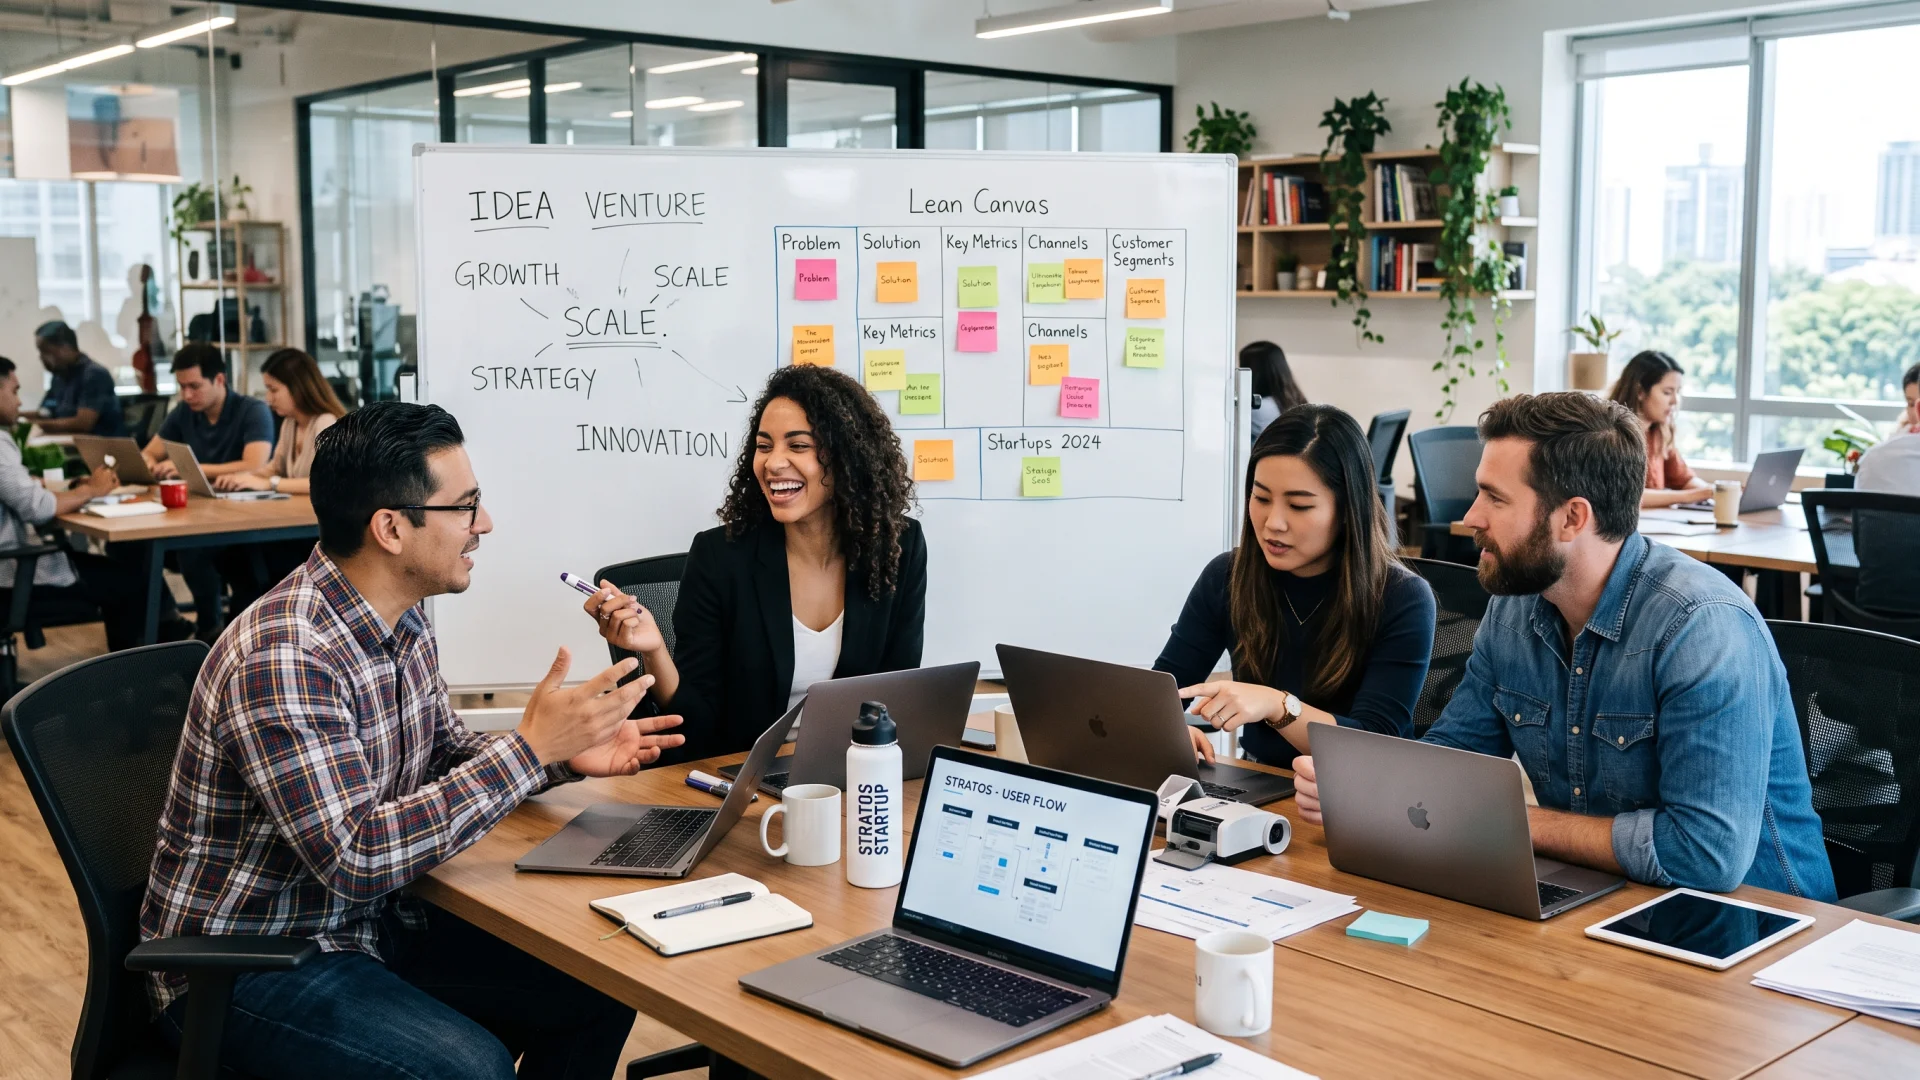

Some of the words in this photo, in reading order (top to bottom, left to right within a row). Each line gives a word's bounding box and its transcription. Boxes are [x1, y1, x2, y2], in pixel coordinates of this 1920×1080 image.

[469, 191, 554, 220] IDEA
[585, 191, 705, 219] VENTURE
[909, 188, 962, 214] Lean
[974, 188, 1049, 214] Canvas
[782, 233, 840, 250] Problem
[863, 233, 921, 250] Solution
[947, 234, 969, 254] Key
[973, 234, 1018, 249] Metrics
[1028, 234, 1088, 250] Channels
[1112, 234, 1173, 250] Customer
[1114, 252, 1174, 271] Segments
[455, 260, 559, 290] GROWTH
[654, 264, 729, 288] SCALE
[799, 273, 830, 283] Problem
[881, 276, 912, 284] Solution
[962, 279, 991, 287] Solution
[1129, 286, 1159, 294] Customer
[863, 325, 885, 344] Key
[891, 324, 936, 339] Metrics
[1028, 323, 1088, 339] Channels
[471, 366, 596, 400] STRATEGY
[577, 424, 727, 458] INNOVATION
[988, 433, 1052, 455] Startups
[1061, 434, 1102, 450] 2024
[917, 455, 949, 464] Solution
[945, 775, 993, 795] STRATOS
[1002, 788, 1031, 804] USER
[1033, 796, 1067, 812] FLOW
[858, 783, 872, 856] STRATOS
[874, 783, 889, 855] STARTUP
